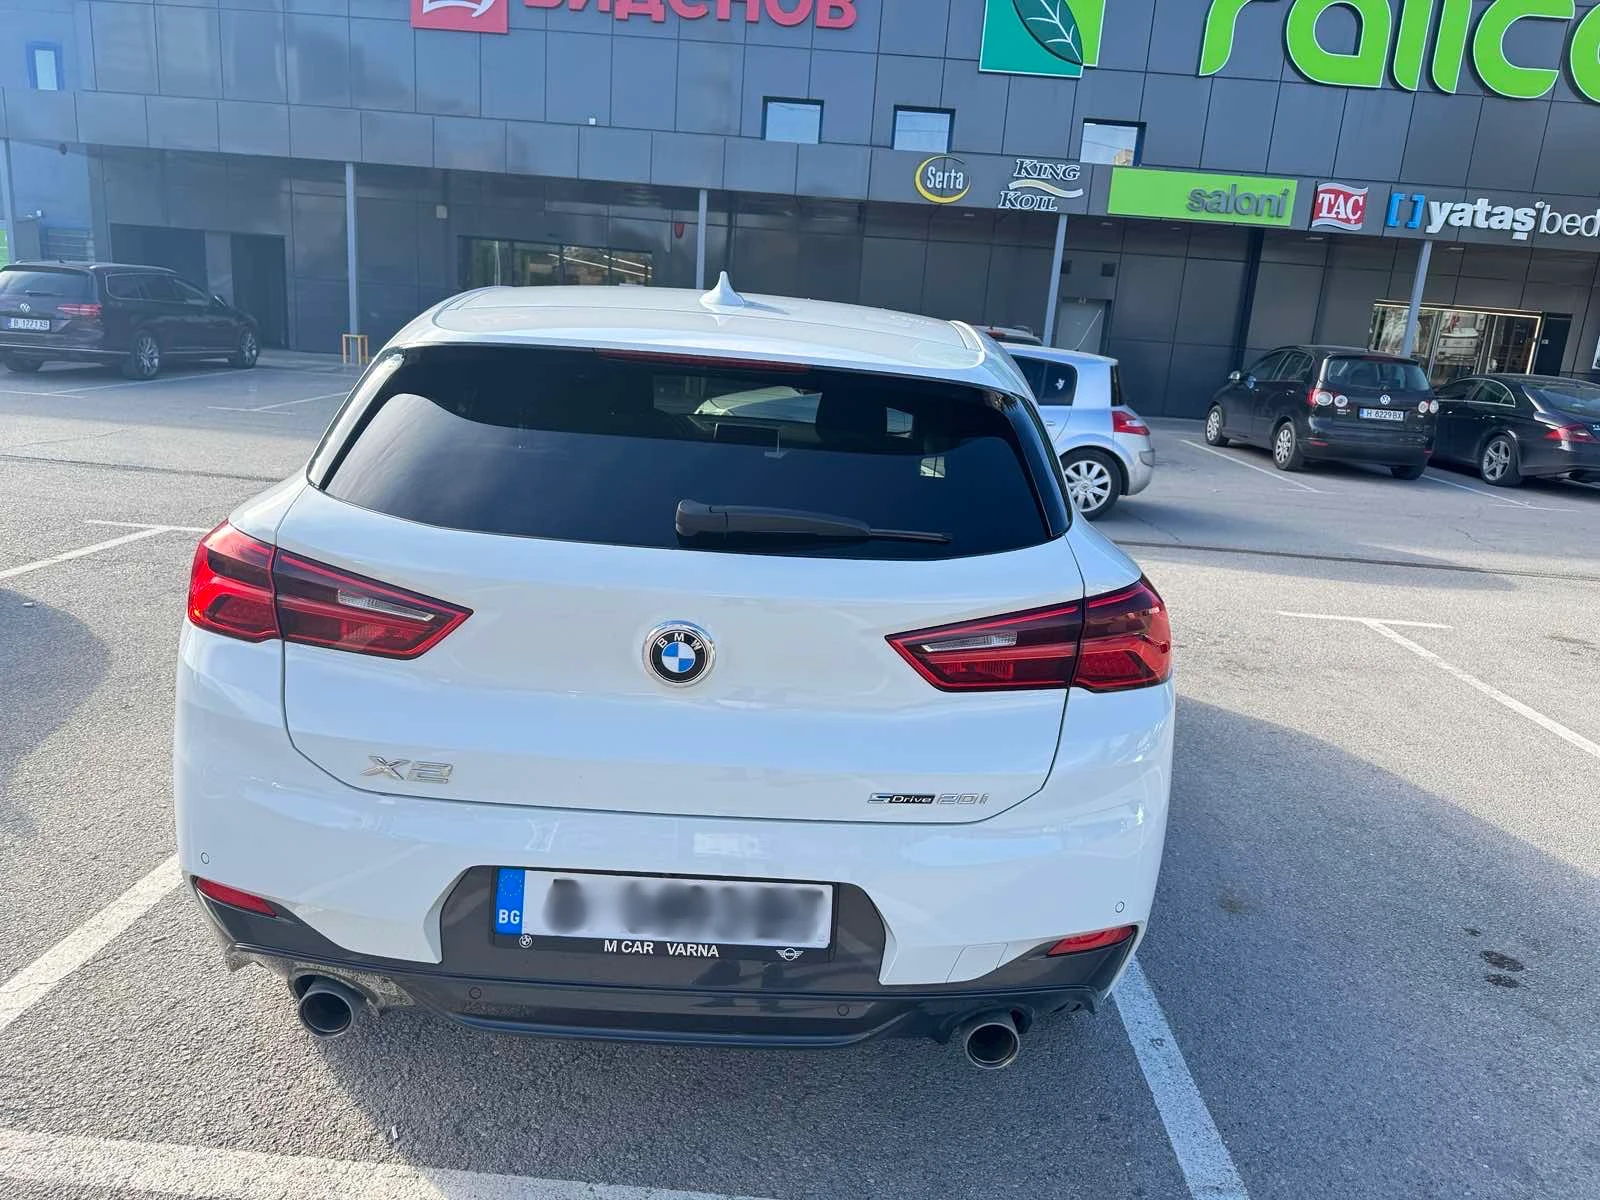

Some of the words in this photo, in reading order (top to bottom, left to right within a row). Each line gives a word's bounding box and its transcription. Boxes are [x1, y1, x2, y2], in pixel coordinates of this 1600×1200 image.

[926, 165, 964, 190] Serta
[1014, 158, 1080, 181] KING
[998, 190, 1058, 212] KOIL
[1186, 183, 1290, 218] saloni
[1425, 197, 1536, 241] yataş
[657, 632, 702, 651] BMW
[360, 755, 453, 784] X2
[498, 909, 520, 924] BG
[603, 938, 618, 953] M
[620, 940, 654, 955] CAR
[666, 942, 720, 958] VARNA
